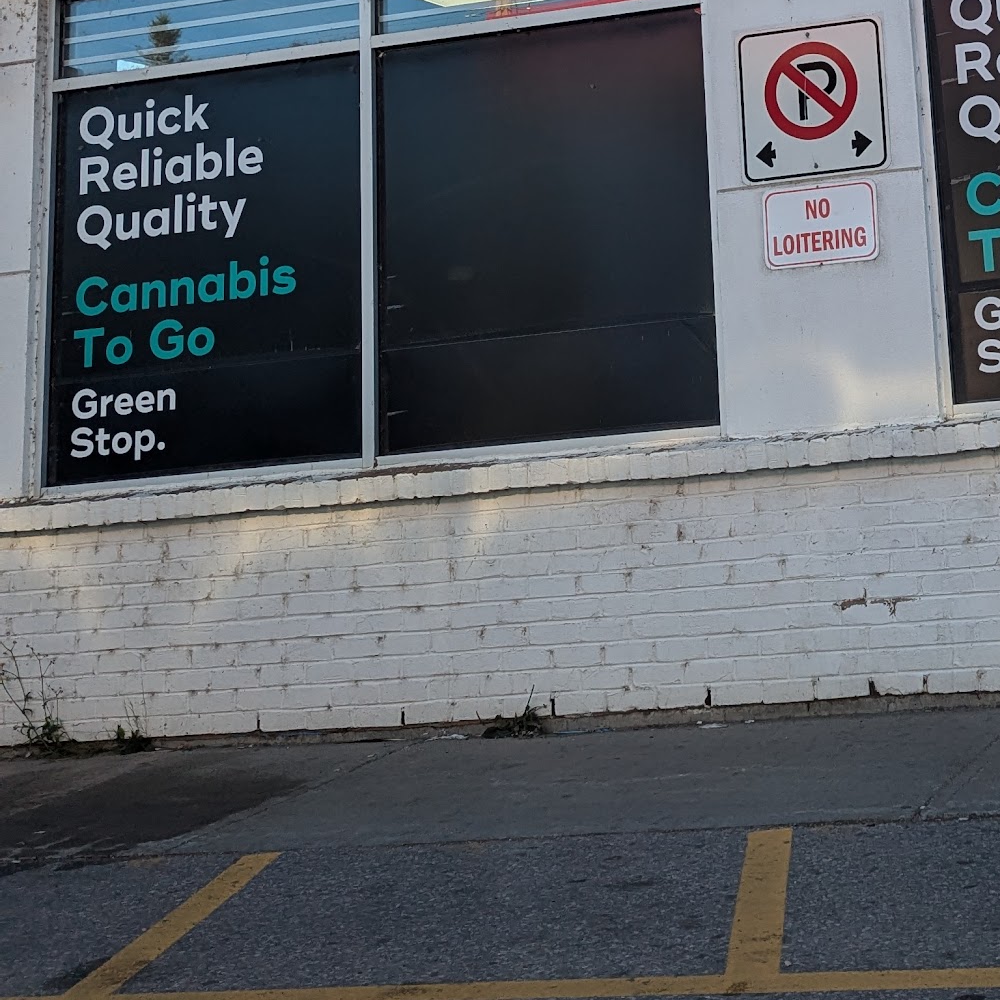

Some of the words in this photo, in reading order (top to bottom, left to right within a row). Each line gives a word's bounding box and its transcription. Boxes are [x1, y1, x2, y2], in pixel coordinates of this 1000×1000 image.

[79, 95, 210, 150] Quick
[79, 137, 264, 195] Reliable
[76, 192, 247, 250] Quality
[805, 198, 830, 220] NO
[773, 226, 867, 256] LOITERING
[75, 256, 297, 316] Cannabis
[73, 328, 133, 368] To
[150, 319, 215, 360] Go
[71, 384, 177, 420] Green
[70, 425, 166, 461] Stop.
